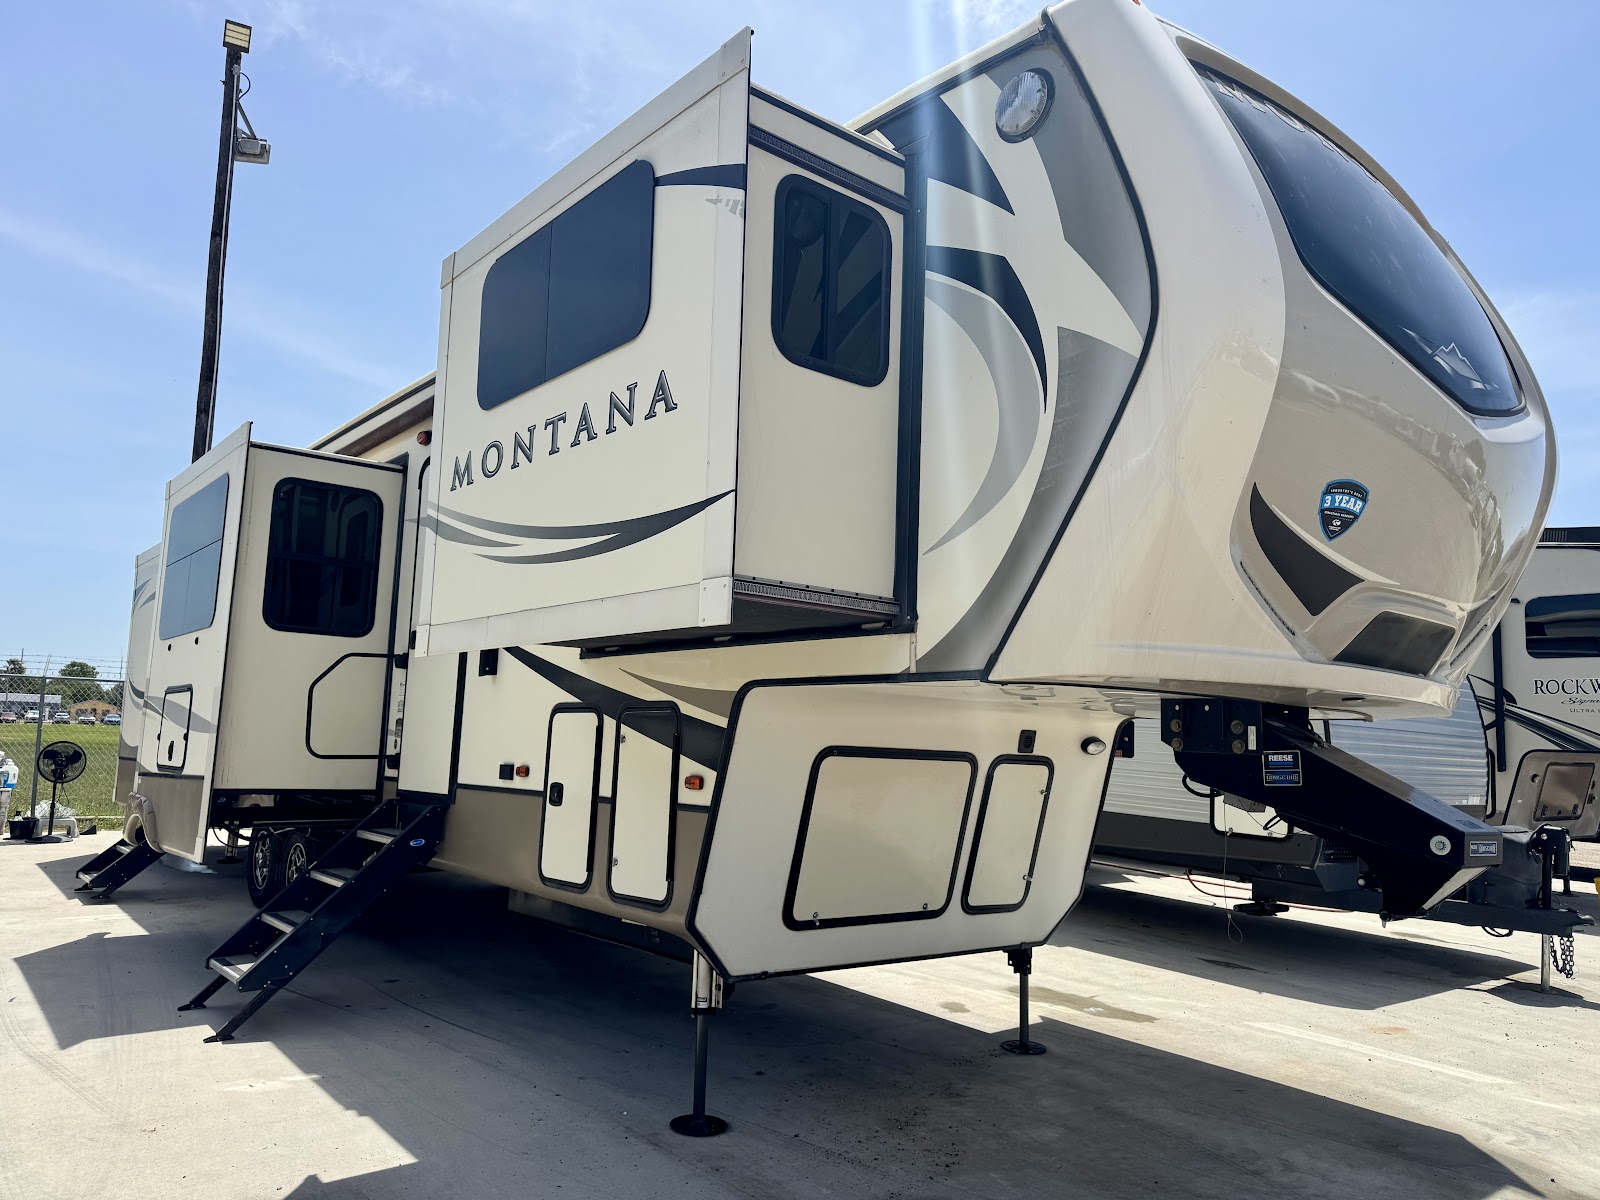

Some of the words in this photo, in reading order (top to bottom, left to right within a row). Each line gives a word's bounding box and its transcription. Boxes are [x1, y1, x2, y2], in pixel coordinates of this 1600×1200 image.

[450, 369, 678, 492] MONTANA
[1323, 495, 1332, 507] 3
[1334, 494, 1363, 513] YEAR
[1268, 754, 1294, 762] REESE
